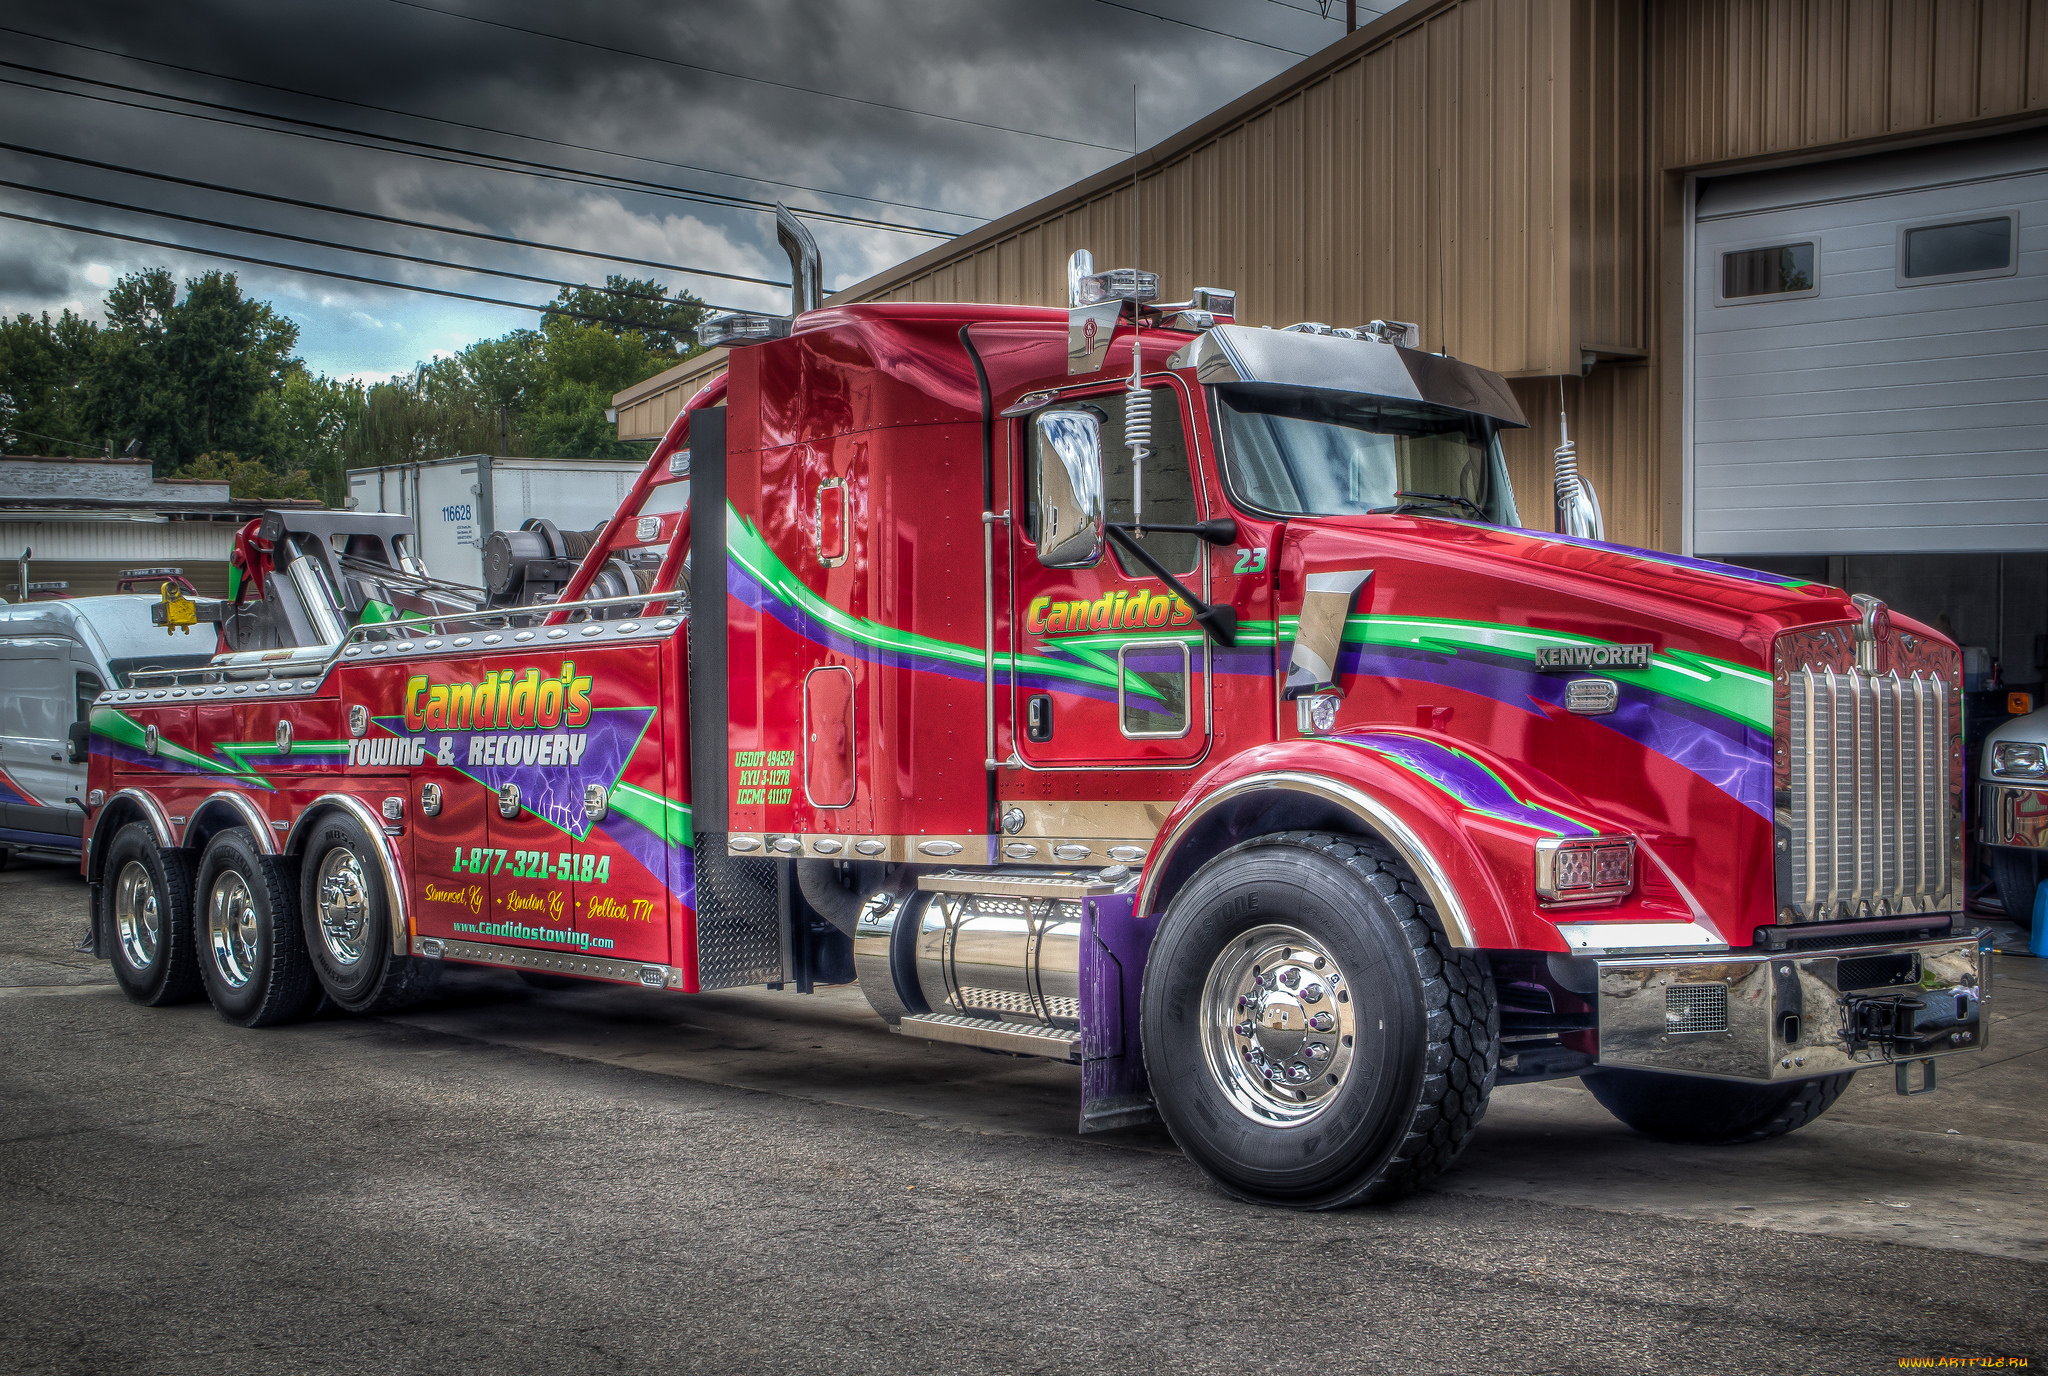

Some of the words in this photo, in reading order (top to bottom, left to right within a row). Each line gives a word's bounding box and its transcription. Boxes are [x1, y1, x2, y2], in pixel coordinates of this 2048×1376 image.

[442, 504, 472, 522] 116628
[1233, 547, 1267, 575] 23
[1027, 588, 1196, 635] Candido's
[1536, 645, 1648, 666] KENWORTH
[404, 660, 593, 732] Candido's
[348, 736, 426, 767] TOWING
[436, 736, 456, 767] &
[468, 733, 588, 767] RECOVERY
[735, 751, 766, 767] USDOT
[766, 750, 795, 767] 494524
[739, 770, 761, 786] KYU
[761, 769, 791, 786] 3-11278
[736, 788, 766, 805] ICCMC
[767, 788, 793, 805] 411137
[452, 846, 611, 884] 1-877-321-5184
[424, 883, 467, 906] Somerset,
[468, 884, 484, 914] Ky
[506, 889, 546, 913] London,
[547, 890, 565, 922] Ky
[587, 895, 630, 922] Jellico,
[632, 899, 654, 924] TN
[453, 921, 615, 950] www.candidostowing.com
